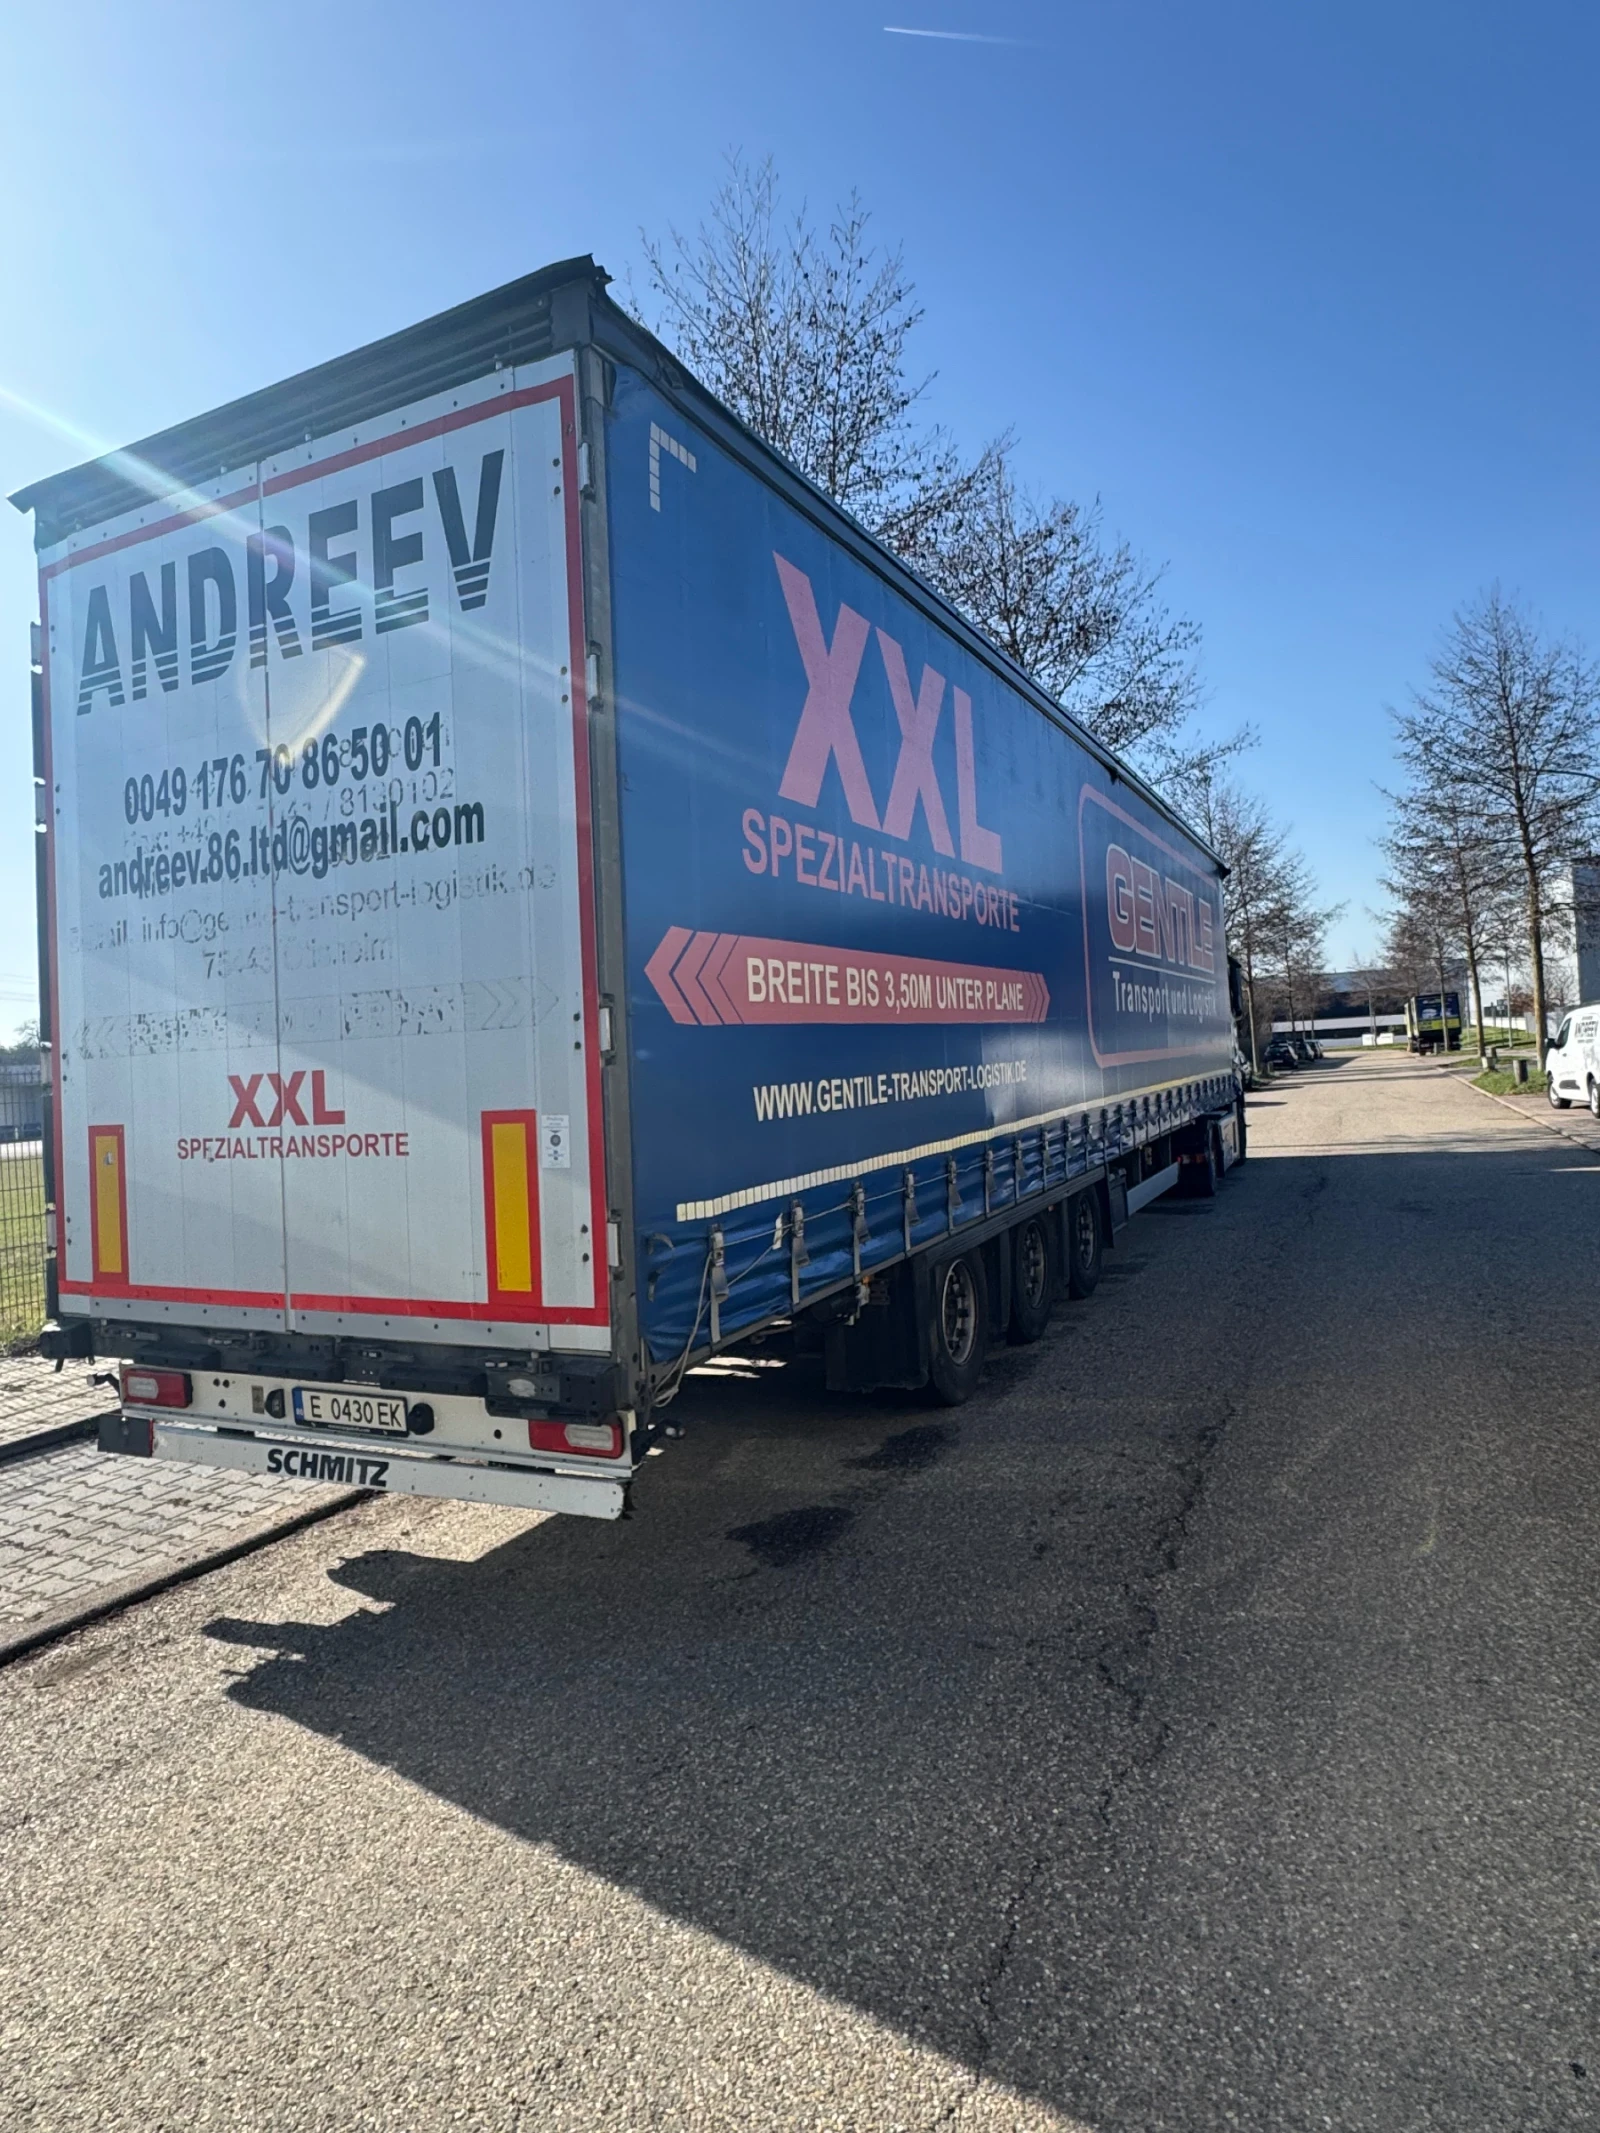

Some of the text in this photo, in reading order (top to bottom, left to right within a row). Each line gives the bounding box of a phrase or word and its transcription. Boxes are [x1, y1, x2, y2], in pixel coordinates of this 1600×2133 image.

[77, 449, 504, 715] ANDREEV
[773, 551, 1002, 875] XXL
[125, 766, 187, 825] 0049
[197, 753, 247, 810] 176
[256, 743, 291, 799] 70
[302, 733, 340, 789] 86
[351, 722, 390, 781] 50
[404, 711, 441, 771] 01
[99, 799, 485, 899] andreev.86.ltd@gmail.com
[742, 808, 1020, 932] SPEZIALTRANSPORTE
[747, 957, 1024, 1014] BREITE BIS 3,50M UNTER PLANE
[1112, 971, 1170, 1022] Transport
[1171, 984, 1187, 1015] und
[227, 1070, 346, 1128] XXL
[753, 1060, 1027, 1122] WWW.GENTILE-TRANSPORT-LOGISTIK.DE
[310, 1395, 402, 1428] E 0430 EK
[267, 1448, 389, 1487] SCHMITZ
